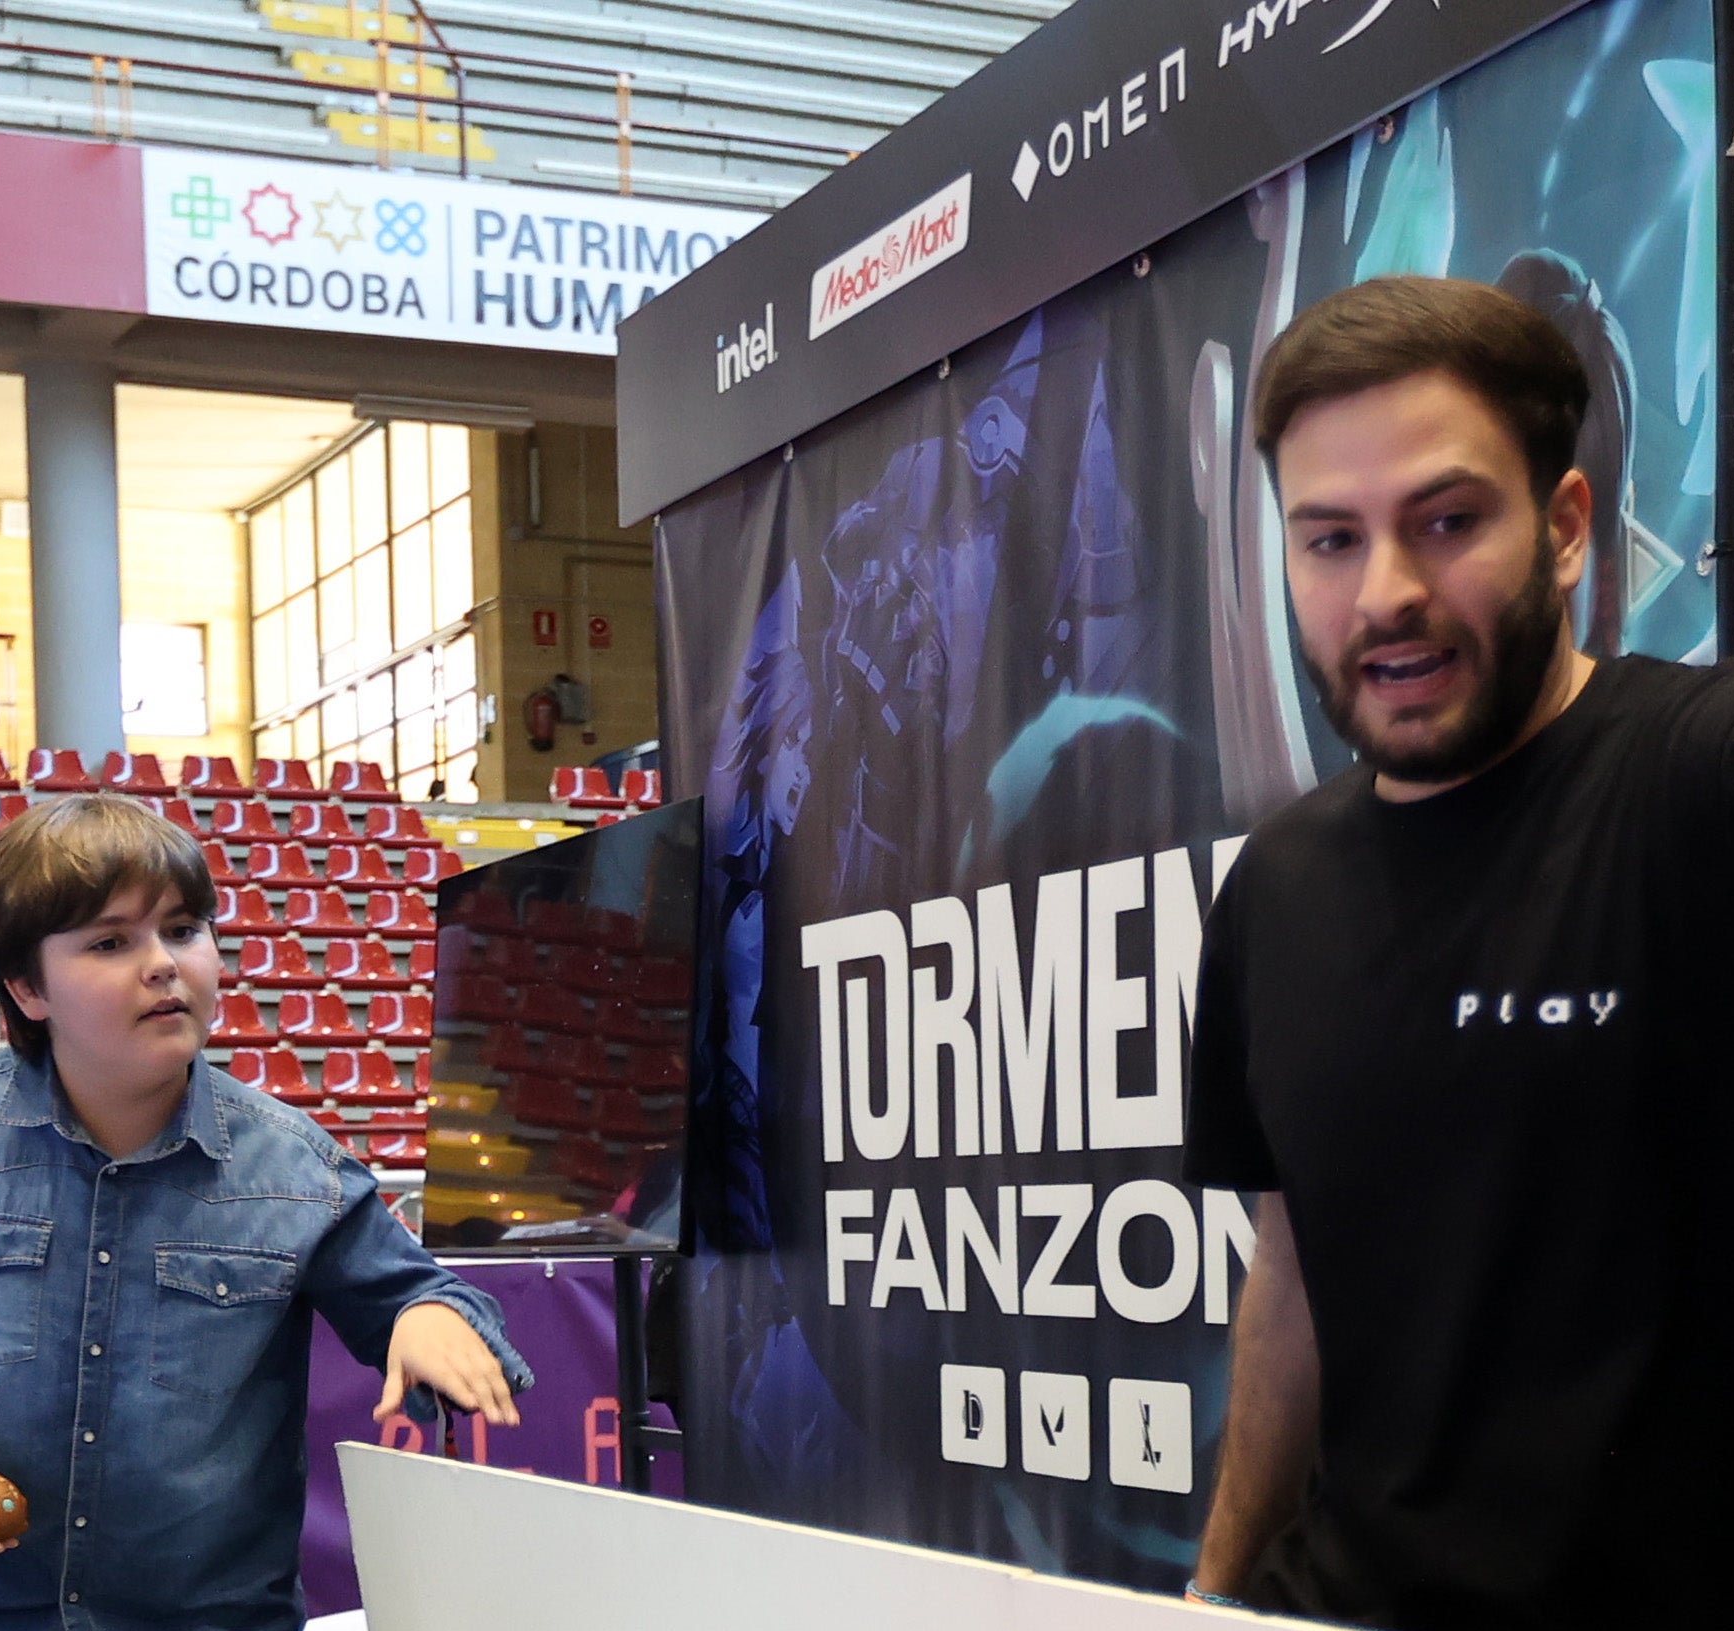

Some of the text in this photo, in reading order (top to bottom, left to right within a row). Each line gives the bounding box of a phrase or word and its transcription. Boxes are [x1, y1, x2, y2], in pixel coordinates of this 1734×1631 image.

[1048, 47, 1187, 178] OMEN
[473, 208, 740, 278] PATRIMO
[174, 250, 426, 320] CÓRDOBA
